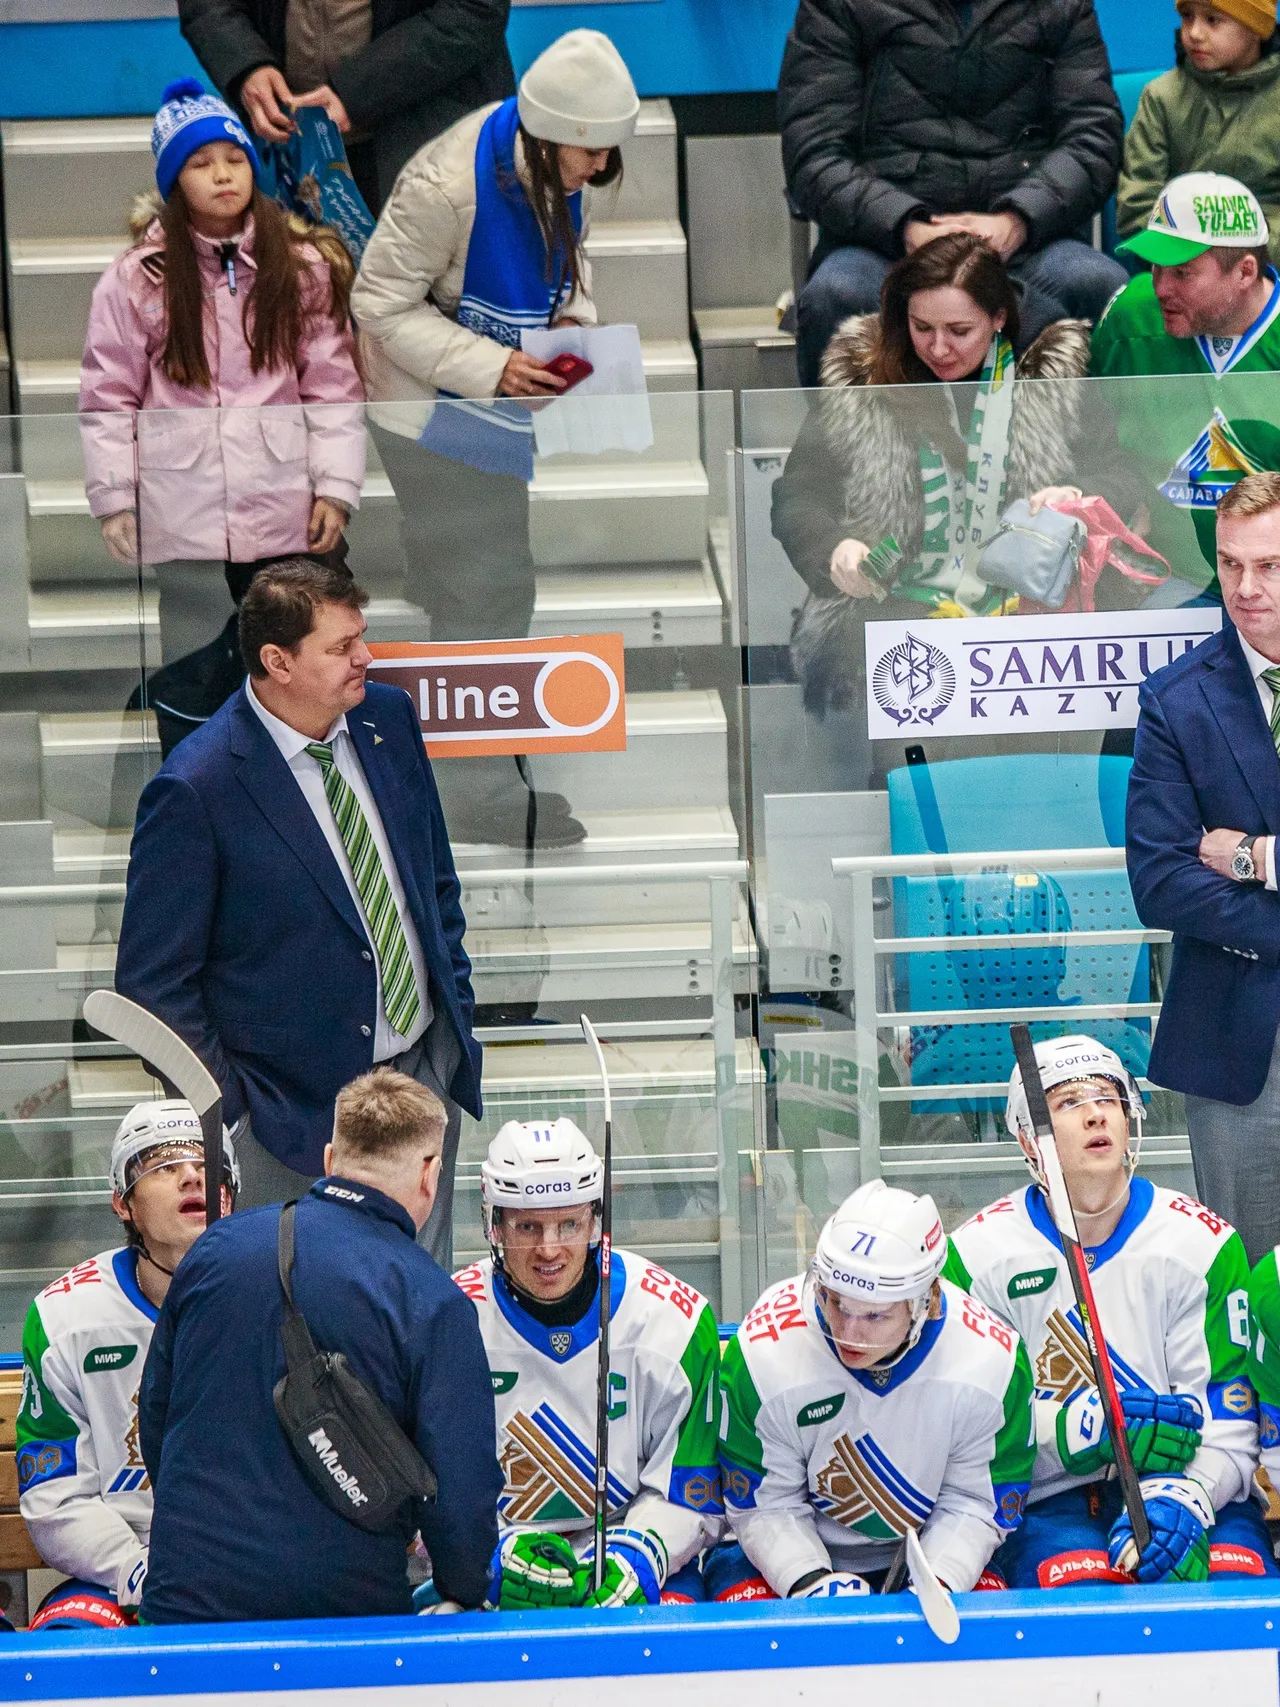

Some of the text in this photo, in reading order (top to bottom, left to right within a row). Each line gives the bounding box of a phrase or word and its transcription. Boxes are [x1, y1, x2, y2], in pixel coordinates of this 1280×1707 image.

[1193, 195, 1252, 216] SALAVAT
[1198, 211, 1257, 233] YULAEV
[1168, 483, 1228, 502] САЛАВА
[404, 677, 520, 722] line
[1055, 1053, 1100, 1069] согаз
[533, 1130, 551, 1143] 11
[324, 1185, 365, 1203] CCM
[525, 1182, 572, 1195] согаз
[851, 1231, 876, 1257] 71
[602, 1235, 610, 1275] CCM
[72, 1260, 101, 1286] ON
[640, 1264, 671, 1301] FO
[832, 1269, 875, 1292] согаз
[1015, 1276, 1044, 1291] МИР
[670, 1280, 699, 1320] BE
[94, 1352, 122, 1364] МИР
[807, 1403, 833, 1420] МИР
[1049, 1557, 1107, 1583] Альфа
[1210, 1550, 1255, 1566] Банк
